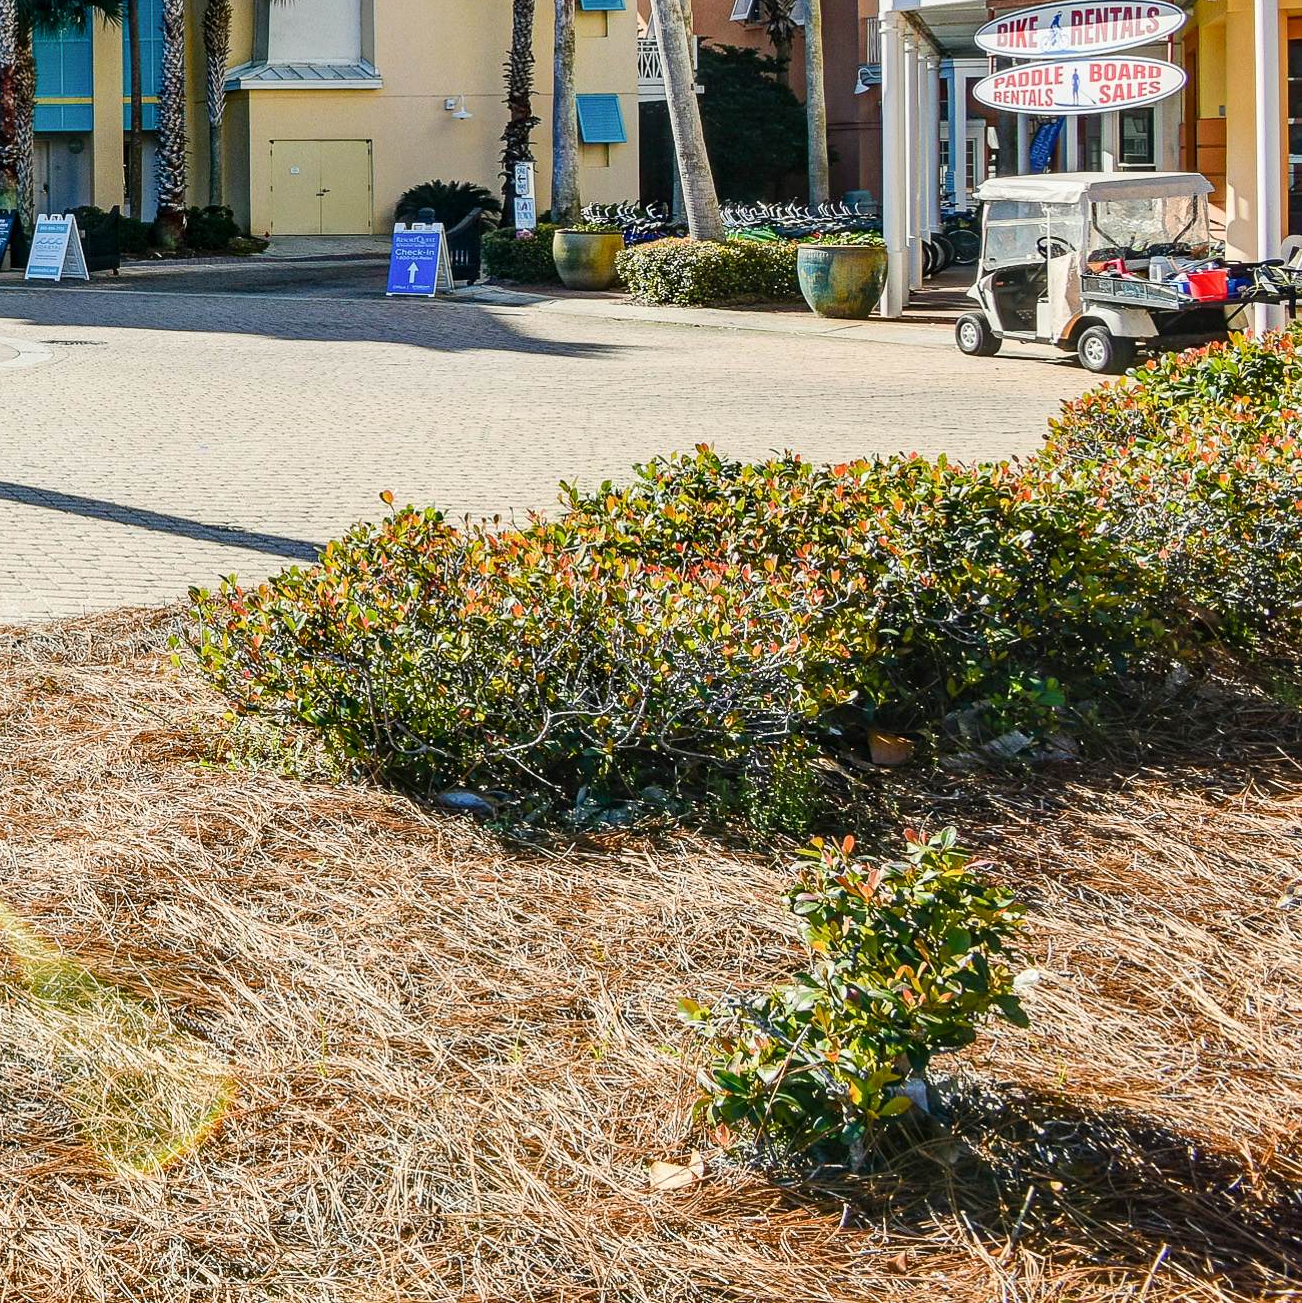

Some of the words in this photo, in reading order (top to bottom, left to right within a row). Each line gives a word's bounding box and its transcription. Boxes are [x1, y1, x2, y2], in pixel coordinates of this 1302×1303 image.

[996, 16, 1039, 48] BIKE
[1070, 6, 1161, 46] RENTALS
[993, 66, 1064, 89] PADDLE
[1089, 63, 1162, 83] BOARD
[993, 88, 1054, 107] RENTALS
[1099, 81, 1161, 104] SALES
[395, 248, 435, 256] Check-In
